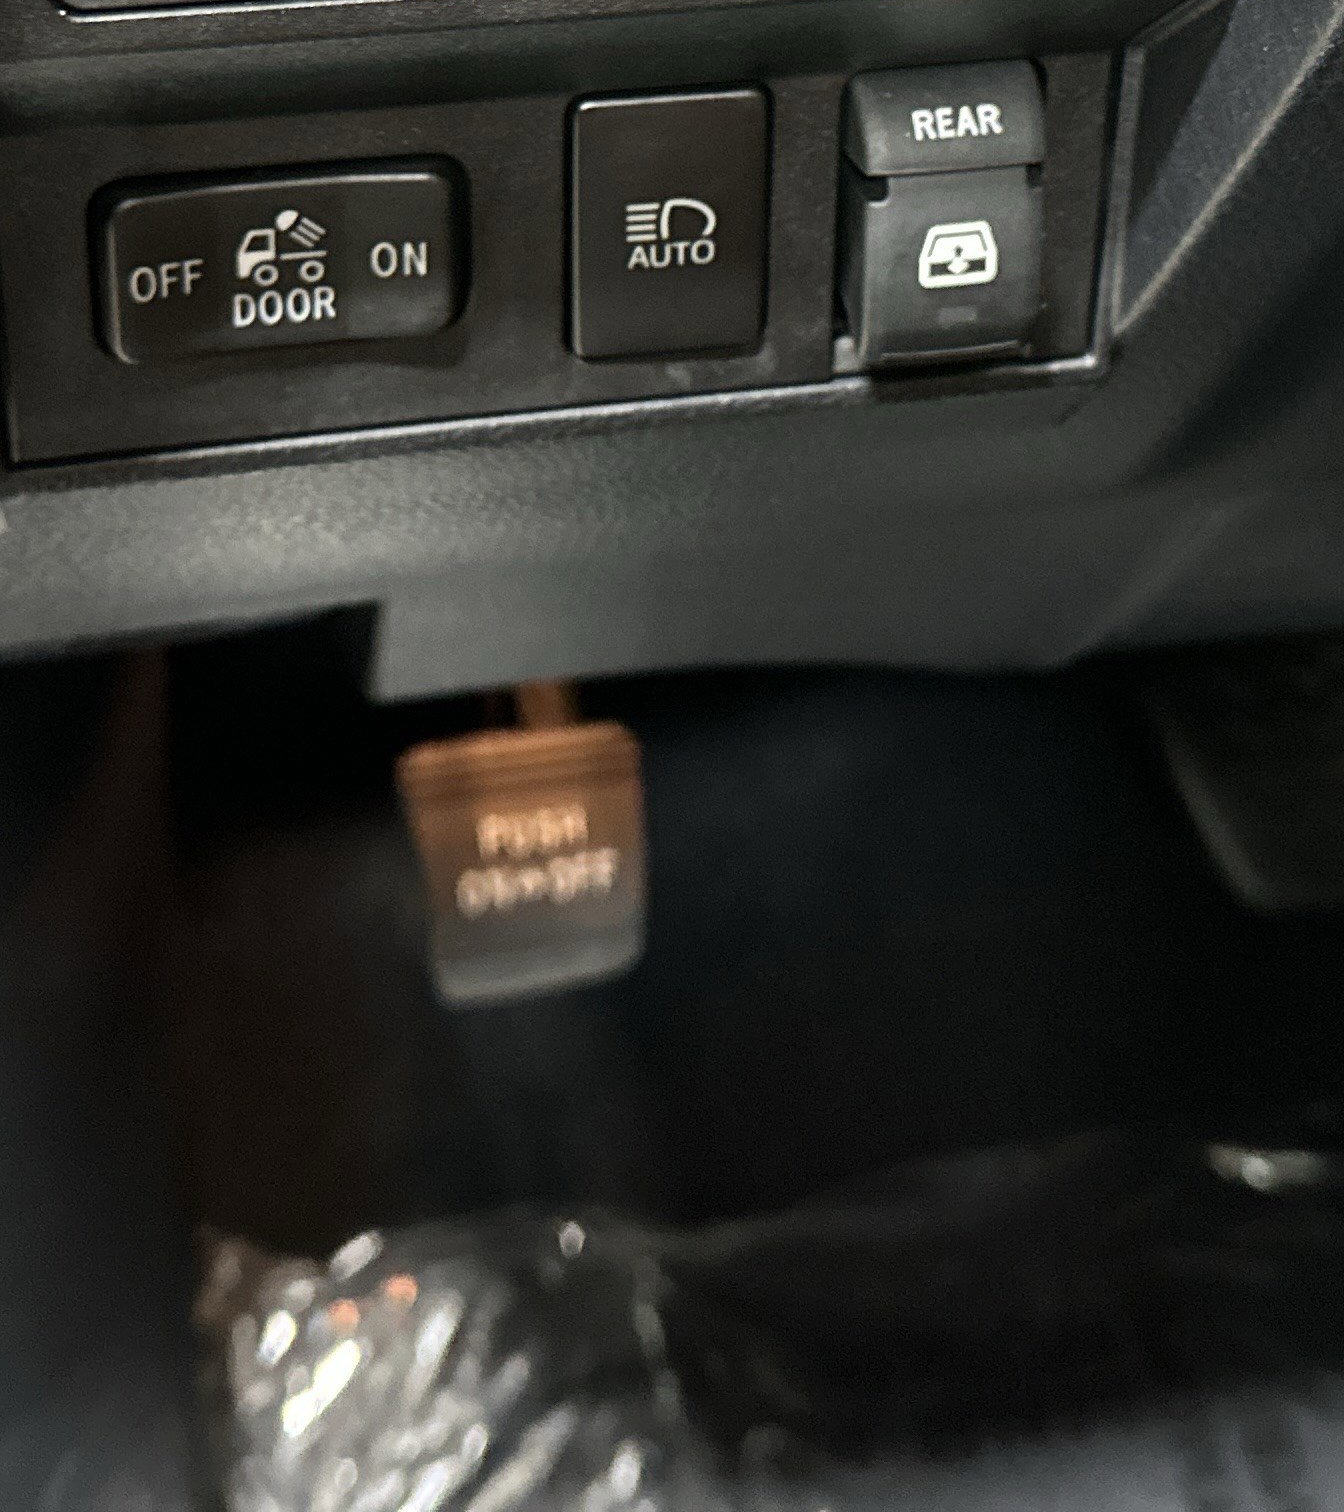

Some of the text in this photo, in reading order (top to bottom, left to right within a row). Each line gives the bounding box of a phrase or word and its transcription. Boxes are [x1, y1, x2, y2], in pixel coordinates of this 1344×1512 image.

[911, 102, 1004, 141] REAR
[370, 241, 429, 278] ON
[627, 239, 717, 270] AUTO
[129, 258, 204, 303] OFF
[232, 286, 337, 328] DOOR
